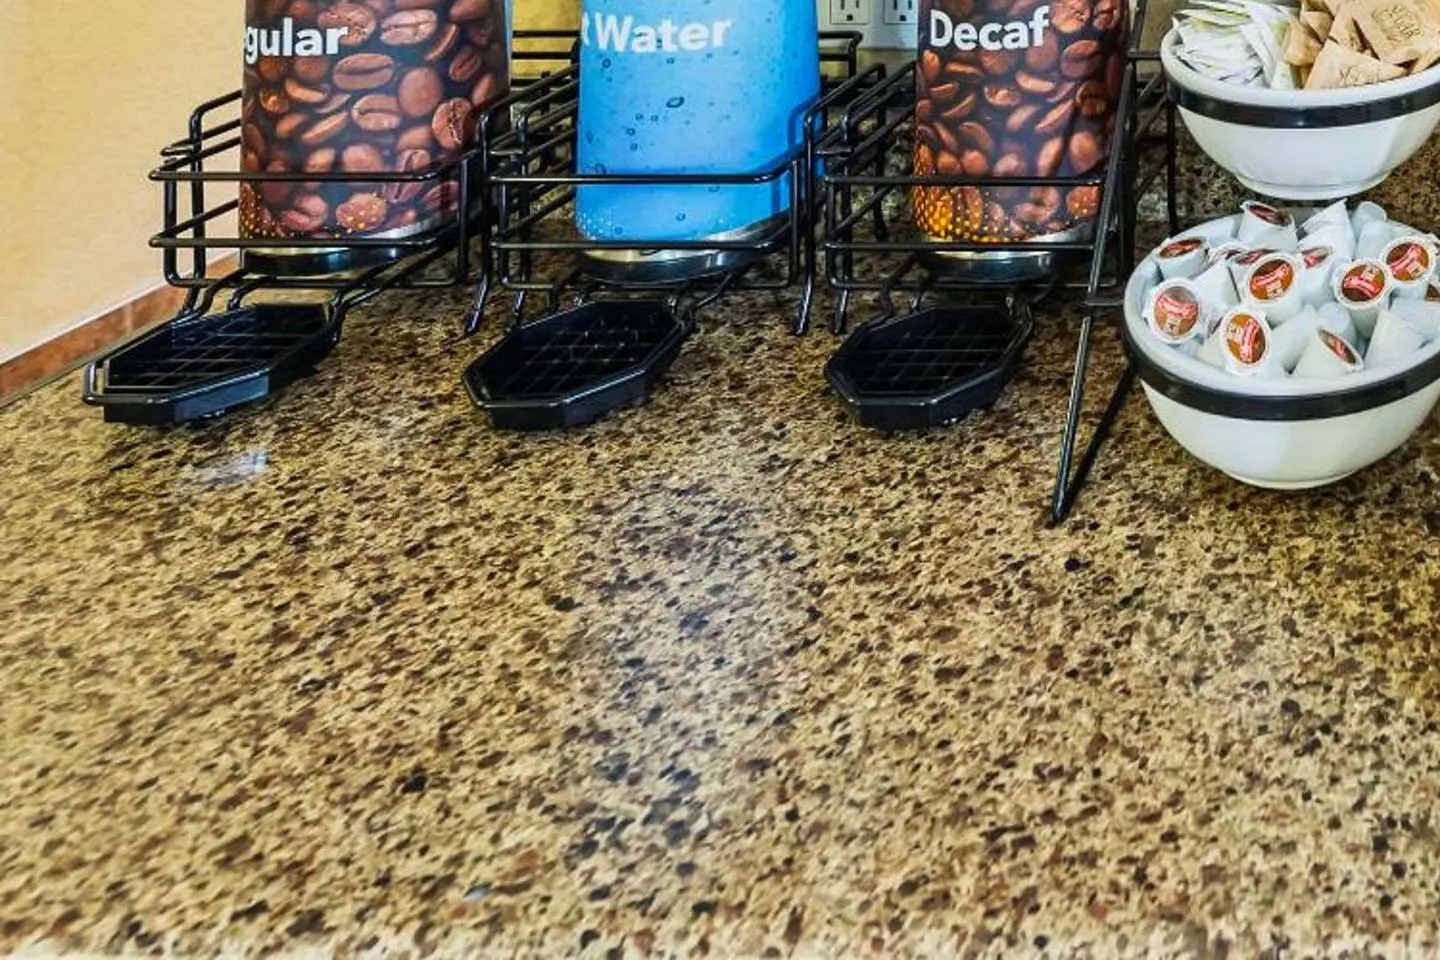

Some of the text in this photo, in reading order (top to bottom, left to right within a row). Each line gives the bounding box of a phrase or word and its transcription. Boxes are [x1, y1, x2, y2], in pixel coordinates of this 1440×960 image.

[244, 16, 349, 65] gular
[594, 11, 733, 53] Water
[929, 5, 1050, 51] Decaf
